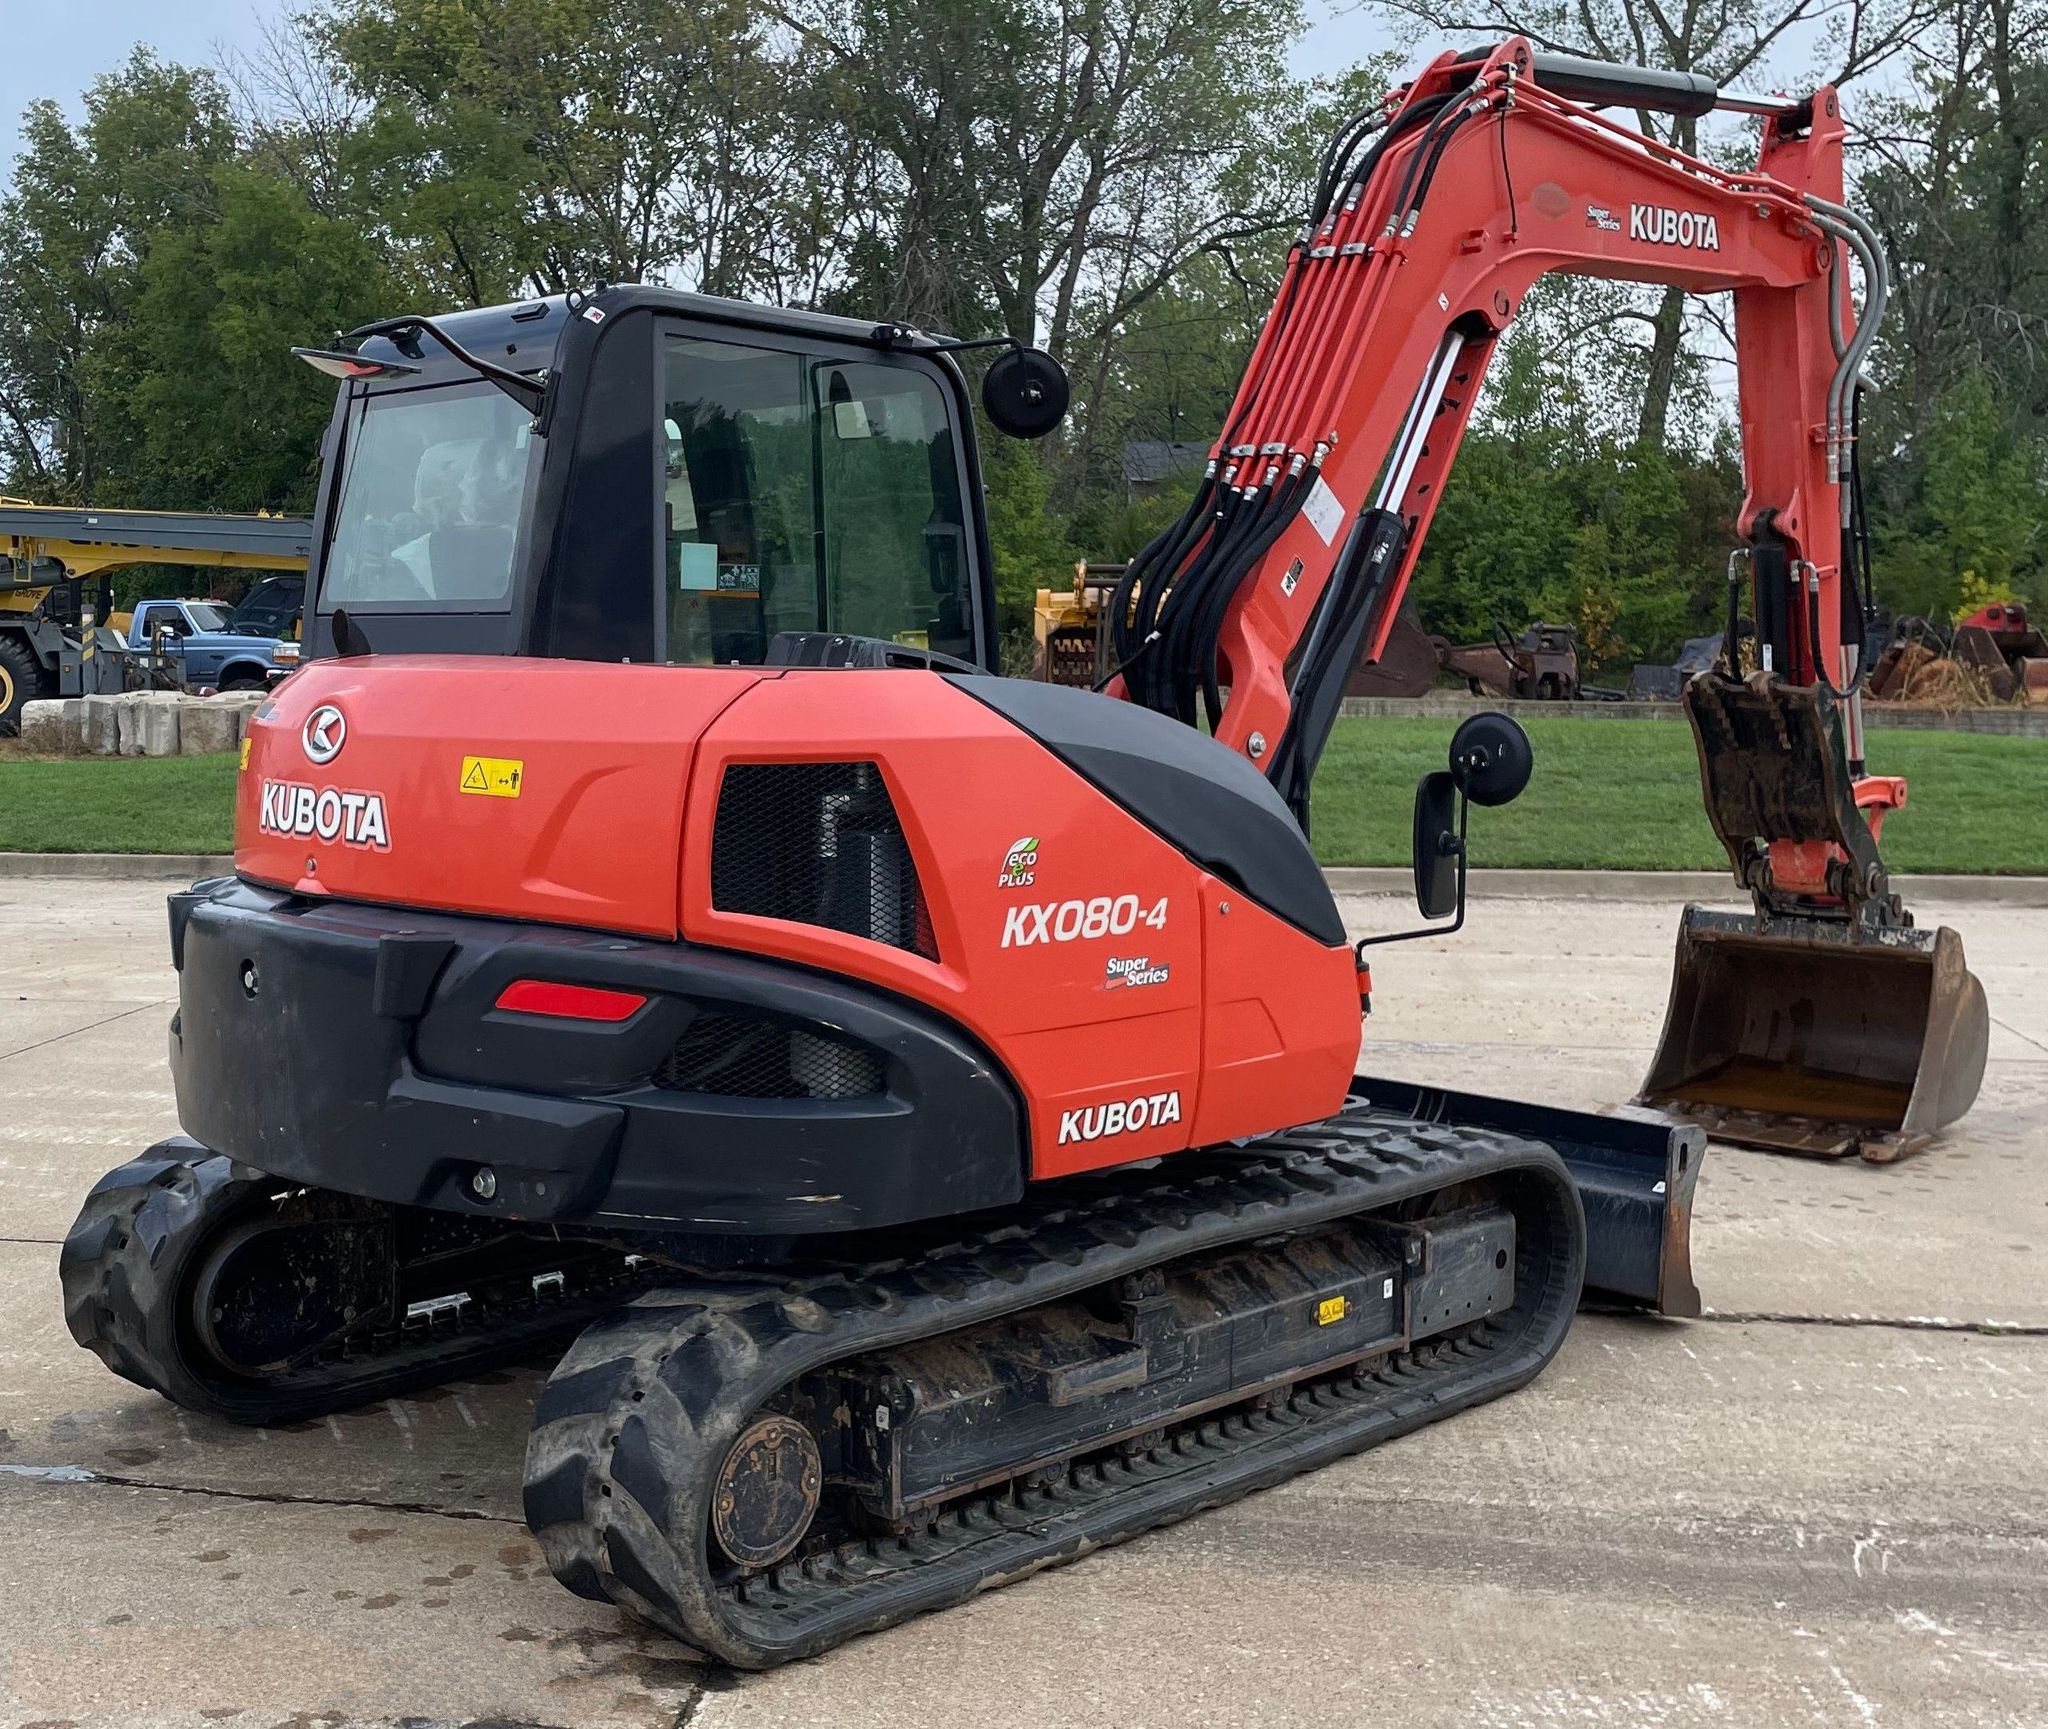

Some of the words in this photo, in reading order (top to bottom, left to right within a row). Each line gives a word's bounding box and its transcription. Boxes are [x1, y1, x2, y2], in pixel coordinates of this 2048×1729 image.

[1597, 218, 1621, 231] Series
[1630, 203, 1719, 250] KUBOTA
[260, 782, 388, 846] KUBOTA
[1008, 852, 1038, 867] eco
[998, 872, 1035, 888] PLUS
[1000, 894, 1169, 949] KX080-4
[1106, 956, 1149, 976] Super
[1126, 967, 1169, 987] Series
[1058, 1091, 1181, 1145] KUBOTA
